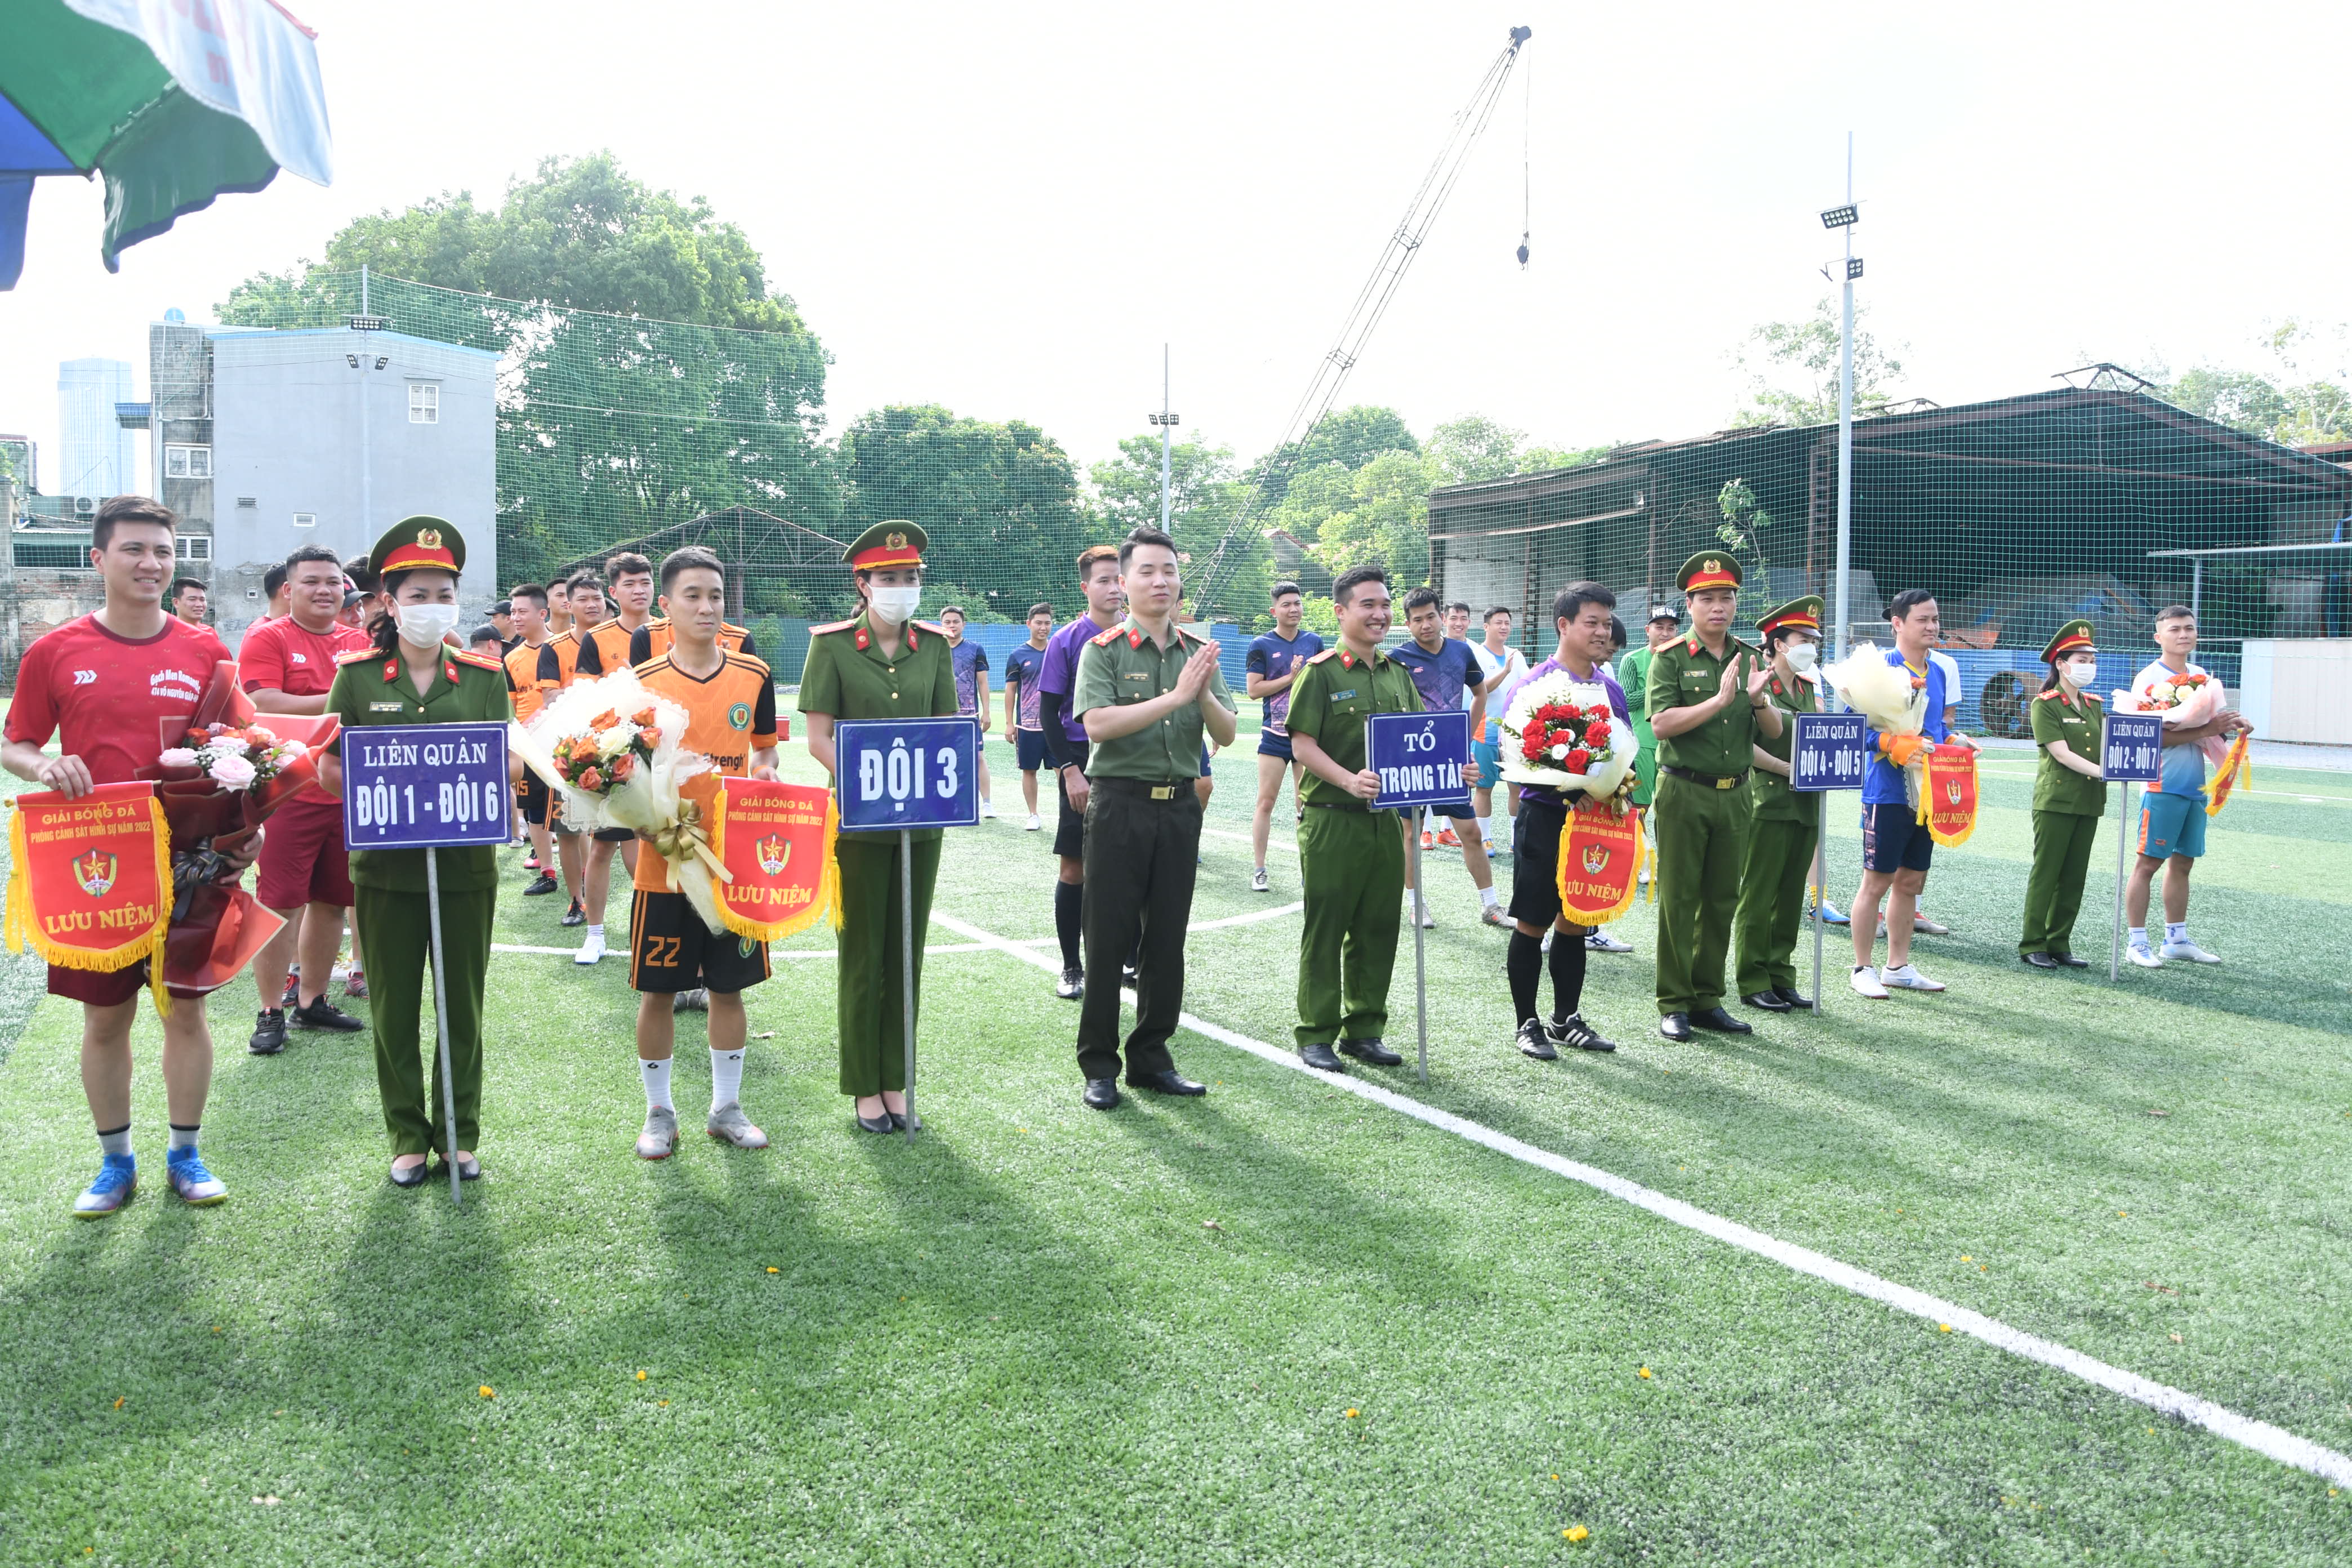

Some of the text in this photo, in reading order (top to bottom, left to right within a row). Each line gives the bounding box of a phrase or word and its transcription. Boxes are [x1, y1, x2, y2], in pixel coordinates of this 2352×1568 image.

[150, 670, 164, 686] Gạch
[165, 669, 178, 680] Men
[1404, 720, 1436, 752] TỔ
[1806, 721, 1858, 740] LIÊN QUÂN
[2113, 720, 2155, 737] LIÊN QUÂN
[363, 737, 487, 767] LIÊN QUÂN
[1800, 745, 1818, 782] ĐỘI
[1820, 751, 1826, 776] 4
[1834, 745, 1852, 781] ĐỘI
[1854, 750, 1860, 776] 5
[2108, 741, 2123, 774] ĐỘI
[2123, 746, 2130, 769] 2
[2136, 742, 2150, 774] ĐỘI
[2151, 747, 2157, 769] 7
[859, 737, 957, 811] ĐỘI 3
[1379, 758, 1463, 798] TRỌNG TÀI
[42, 804, 136, 825] GIẢI BÓNG ĐÁ
[357, 776, 397, 835] ĐỘI
[404, 785, 415, 824] 1
[439, 774, 478, 831] ĐỘI
[485, 782, 498, 821] 6
[740, 795, 813, 811] GIẢI BÓNG ĐÁ
[809, 816, 823, 826] 2022
[1933, 810, 1971, 826] LƯU NIỆM
[31, 821, 151, 843] PHÒNG CẢNH SÁT HÌNH SỰ NĂM 2022
[727, 884, 812, 908] LƯU NIỆM
[1567, 879, 1622, 902] ƯU NIỆM
[45, 901, 155, 934] LƯU NIỆM
[645, 936, 680, 967] 22
